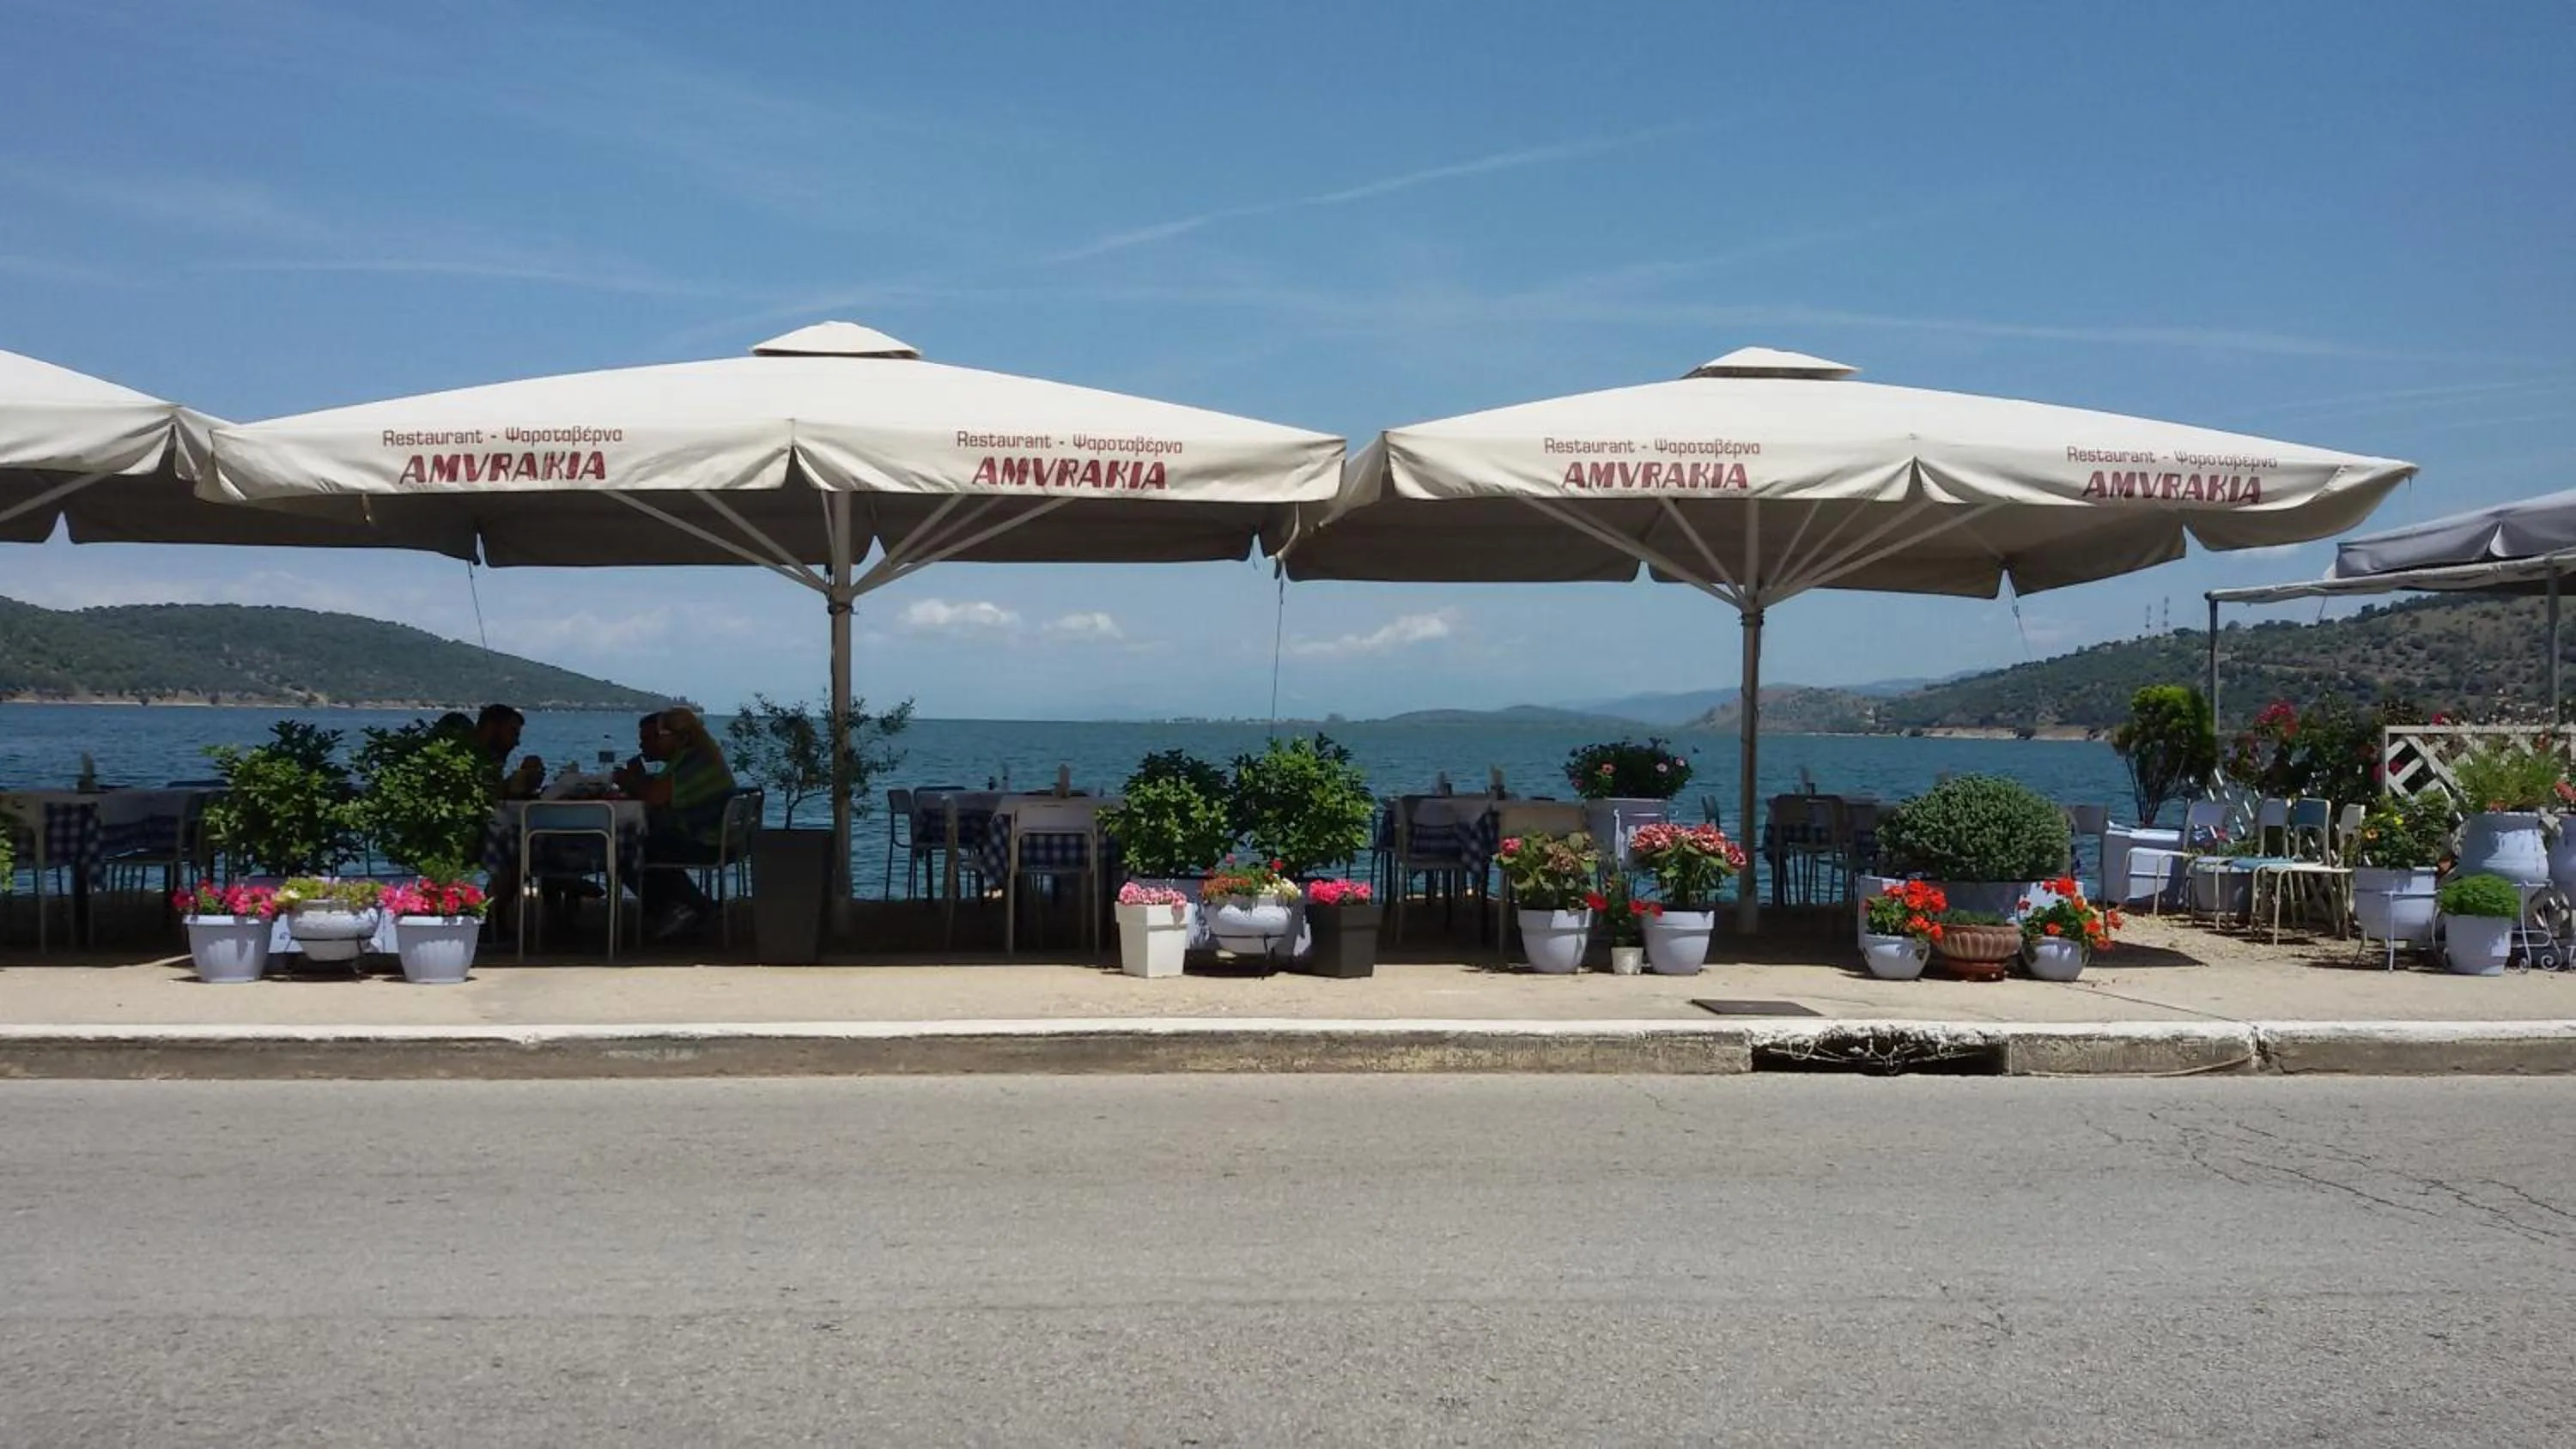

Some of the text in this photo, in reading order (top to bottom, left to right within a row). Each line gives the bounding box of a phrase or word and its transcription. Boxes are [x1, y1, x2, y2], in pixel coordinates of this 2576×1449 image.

[383, 429, 483, 447] Restaurant
[506, 426, 623, 447] Ψαροταβέρνα
[957, 430, 1052, 449] Restaurant
[1073, 433, 1183, 457] Ψαροταβέρνα
[1544, 437, 1636, 454] Restaurant
[1655, 439, 1760, 458] Ψαροταβέρνα
[398, 451, 606, 484] AMVRAKIA
[2067, 446, 2156, 464] Restaurant
[972, 457, 1166, 489] AMVRAKIA
[1561, 461, 1748, 489] AMVRAKIA
[2081, 470, 2261, 503] AMVRAKIA
